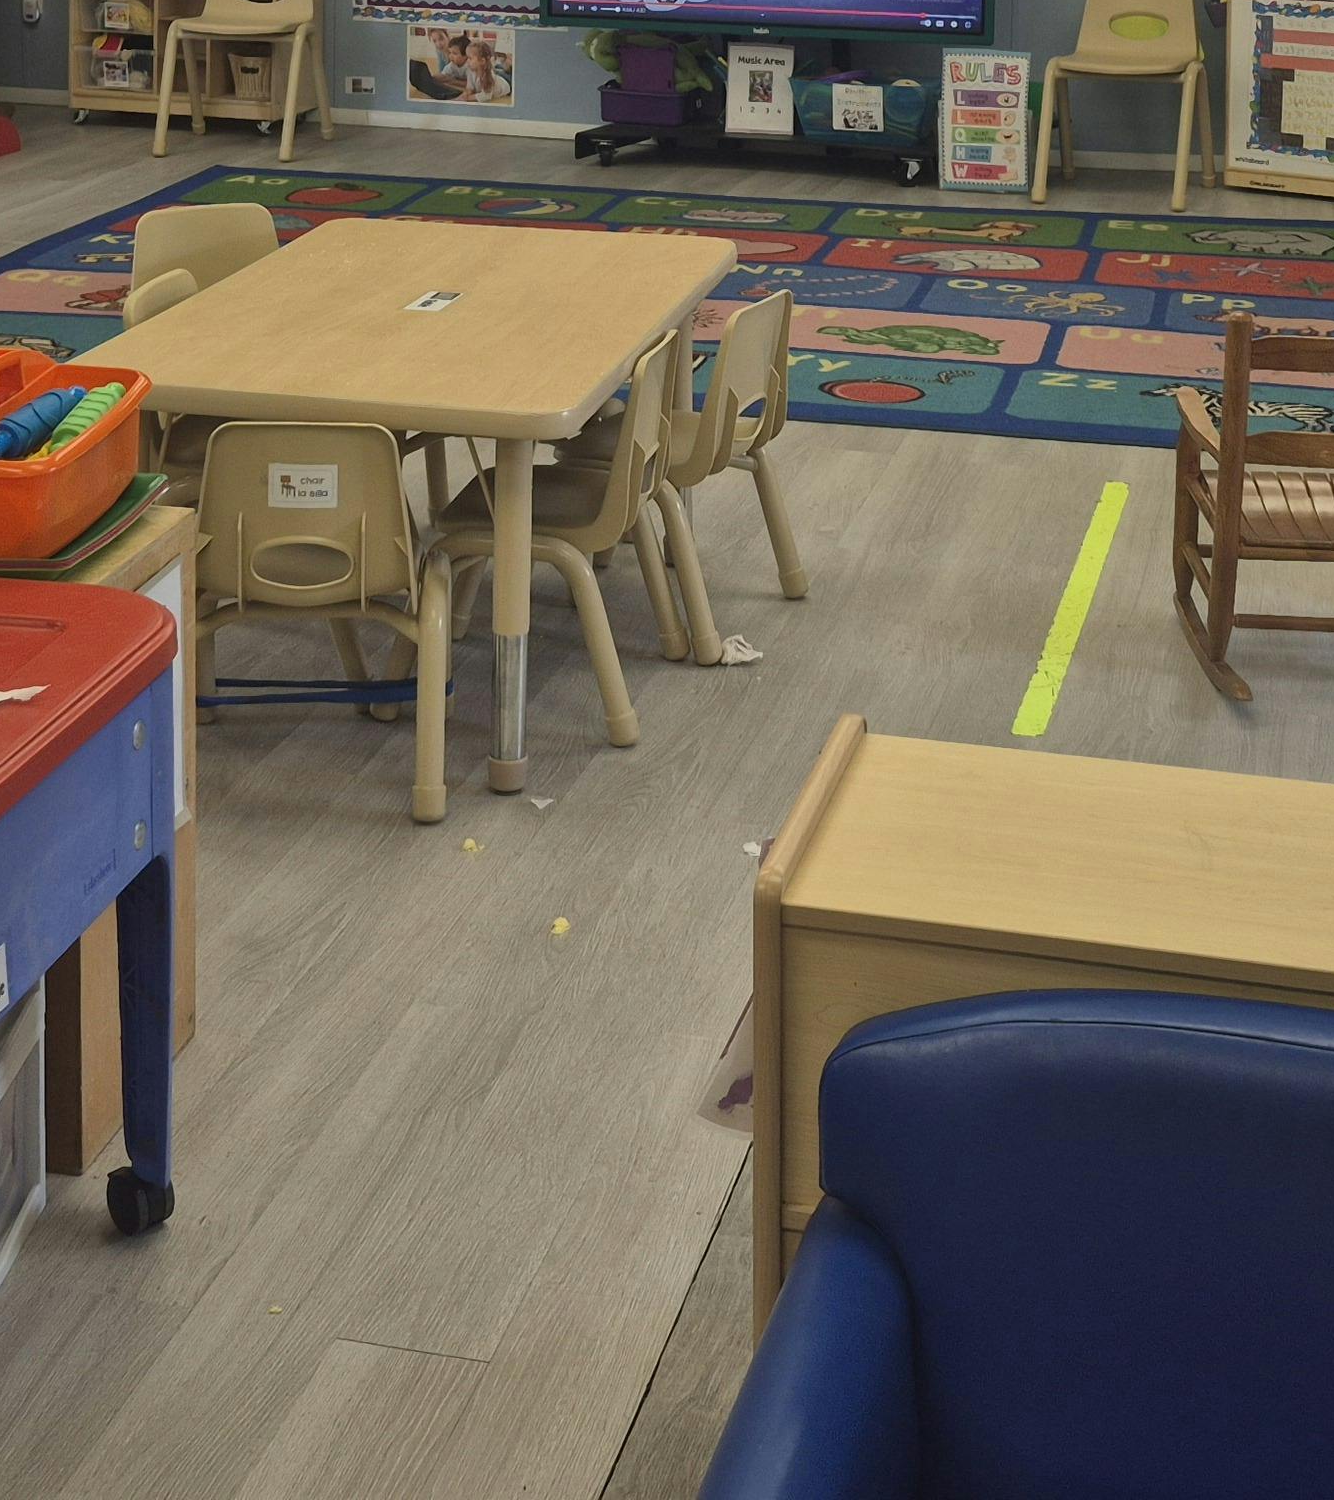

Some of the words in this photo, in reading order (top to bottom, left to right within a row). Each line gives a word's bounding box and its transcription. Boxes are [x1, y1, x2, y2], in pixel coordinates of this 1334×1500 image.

[738, 55, 762, 65] Music
[764, 56, 786, 66] Area
[950, 62, 1021, 85] RULES
[225, 174, 290, 187] Aa
[444, 185, 505, 197] Bb
[947, 278, 1028, 293] Oo
[300, 476, 325, 485] chair
